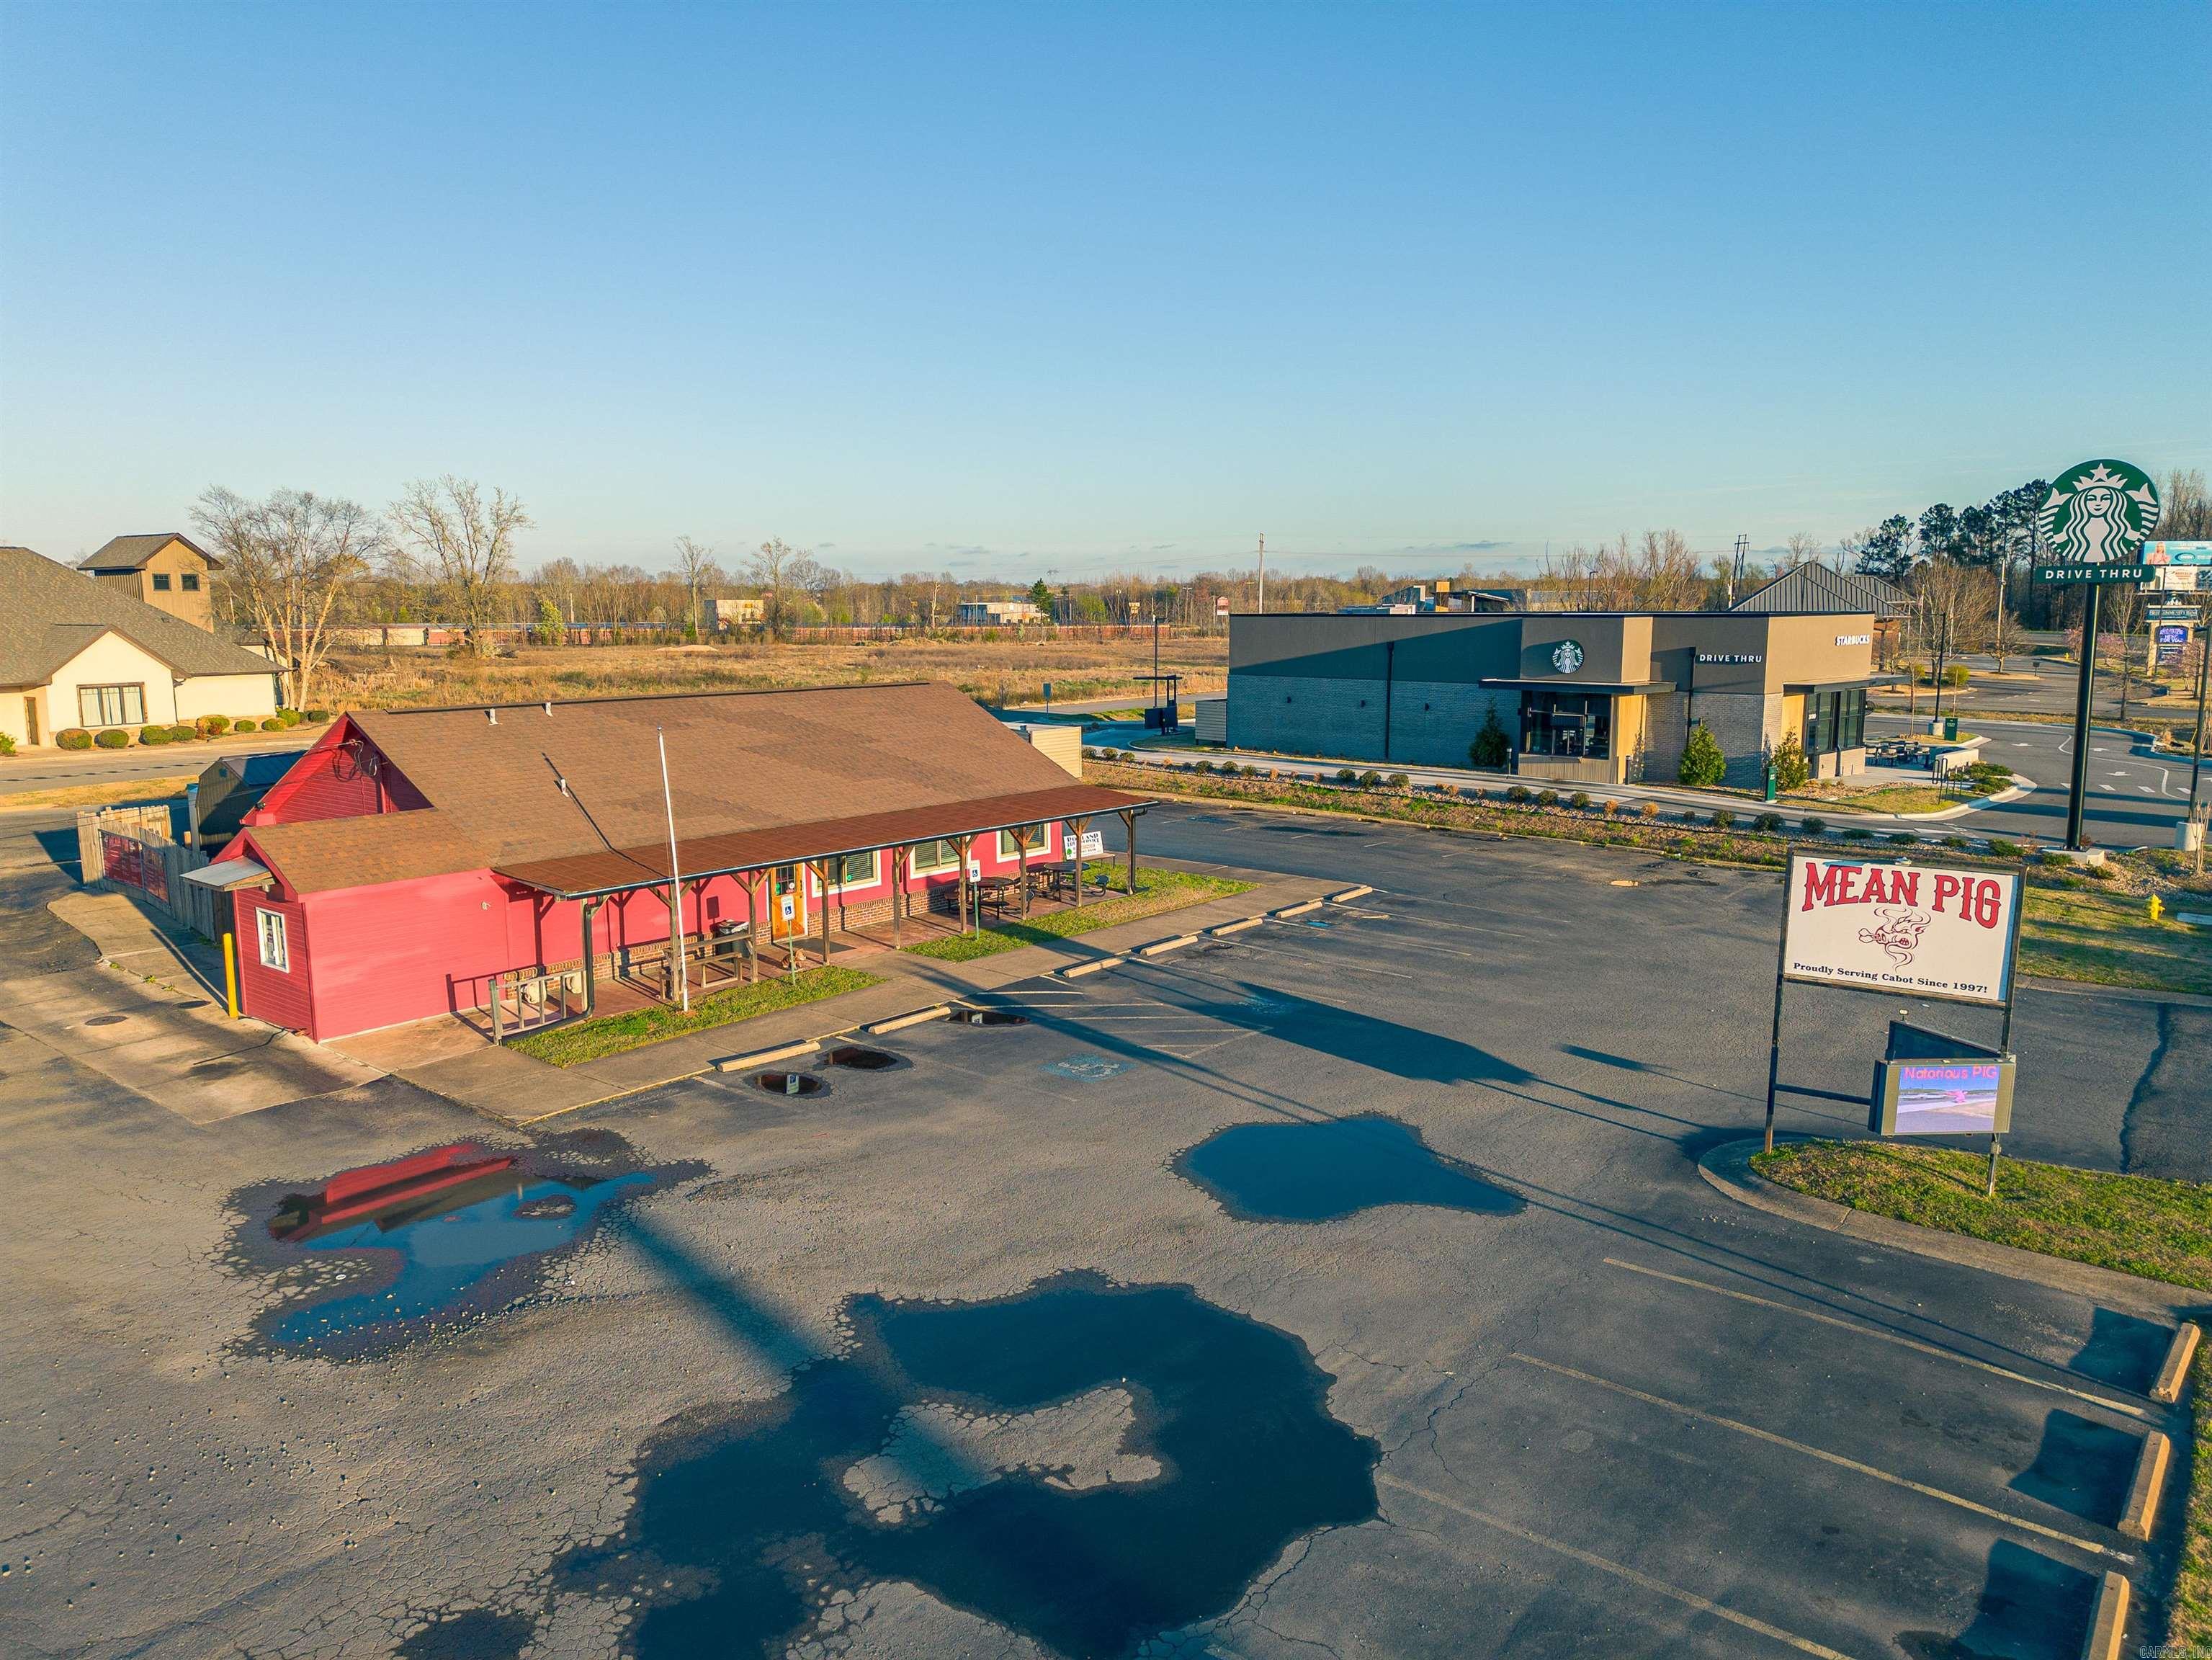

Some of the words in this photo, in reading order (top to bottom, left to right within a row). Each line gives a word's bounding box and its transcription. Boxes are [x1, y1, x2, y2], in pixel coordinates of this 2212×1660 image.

[2045, 570, 2092, 579] DRIVE
[2100, 569, 2142, 579] THRU
[1835, 634, 1871, 646] STARBUCKS
[1802, 862, 1921, 912] MEAN
[1932, 875, 2001, 929] PIG
[1794, 962, 1834, 976] Proudly
[1837, 968, 1879, 981] Serving
[1881, 973, 1913, 984] Cabot
[1917, 978, 1948, 989] Since
[1953, 982, 1987, 994] 1997!
[1972, 1064, 1997, 1079] PIG
